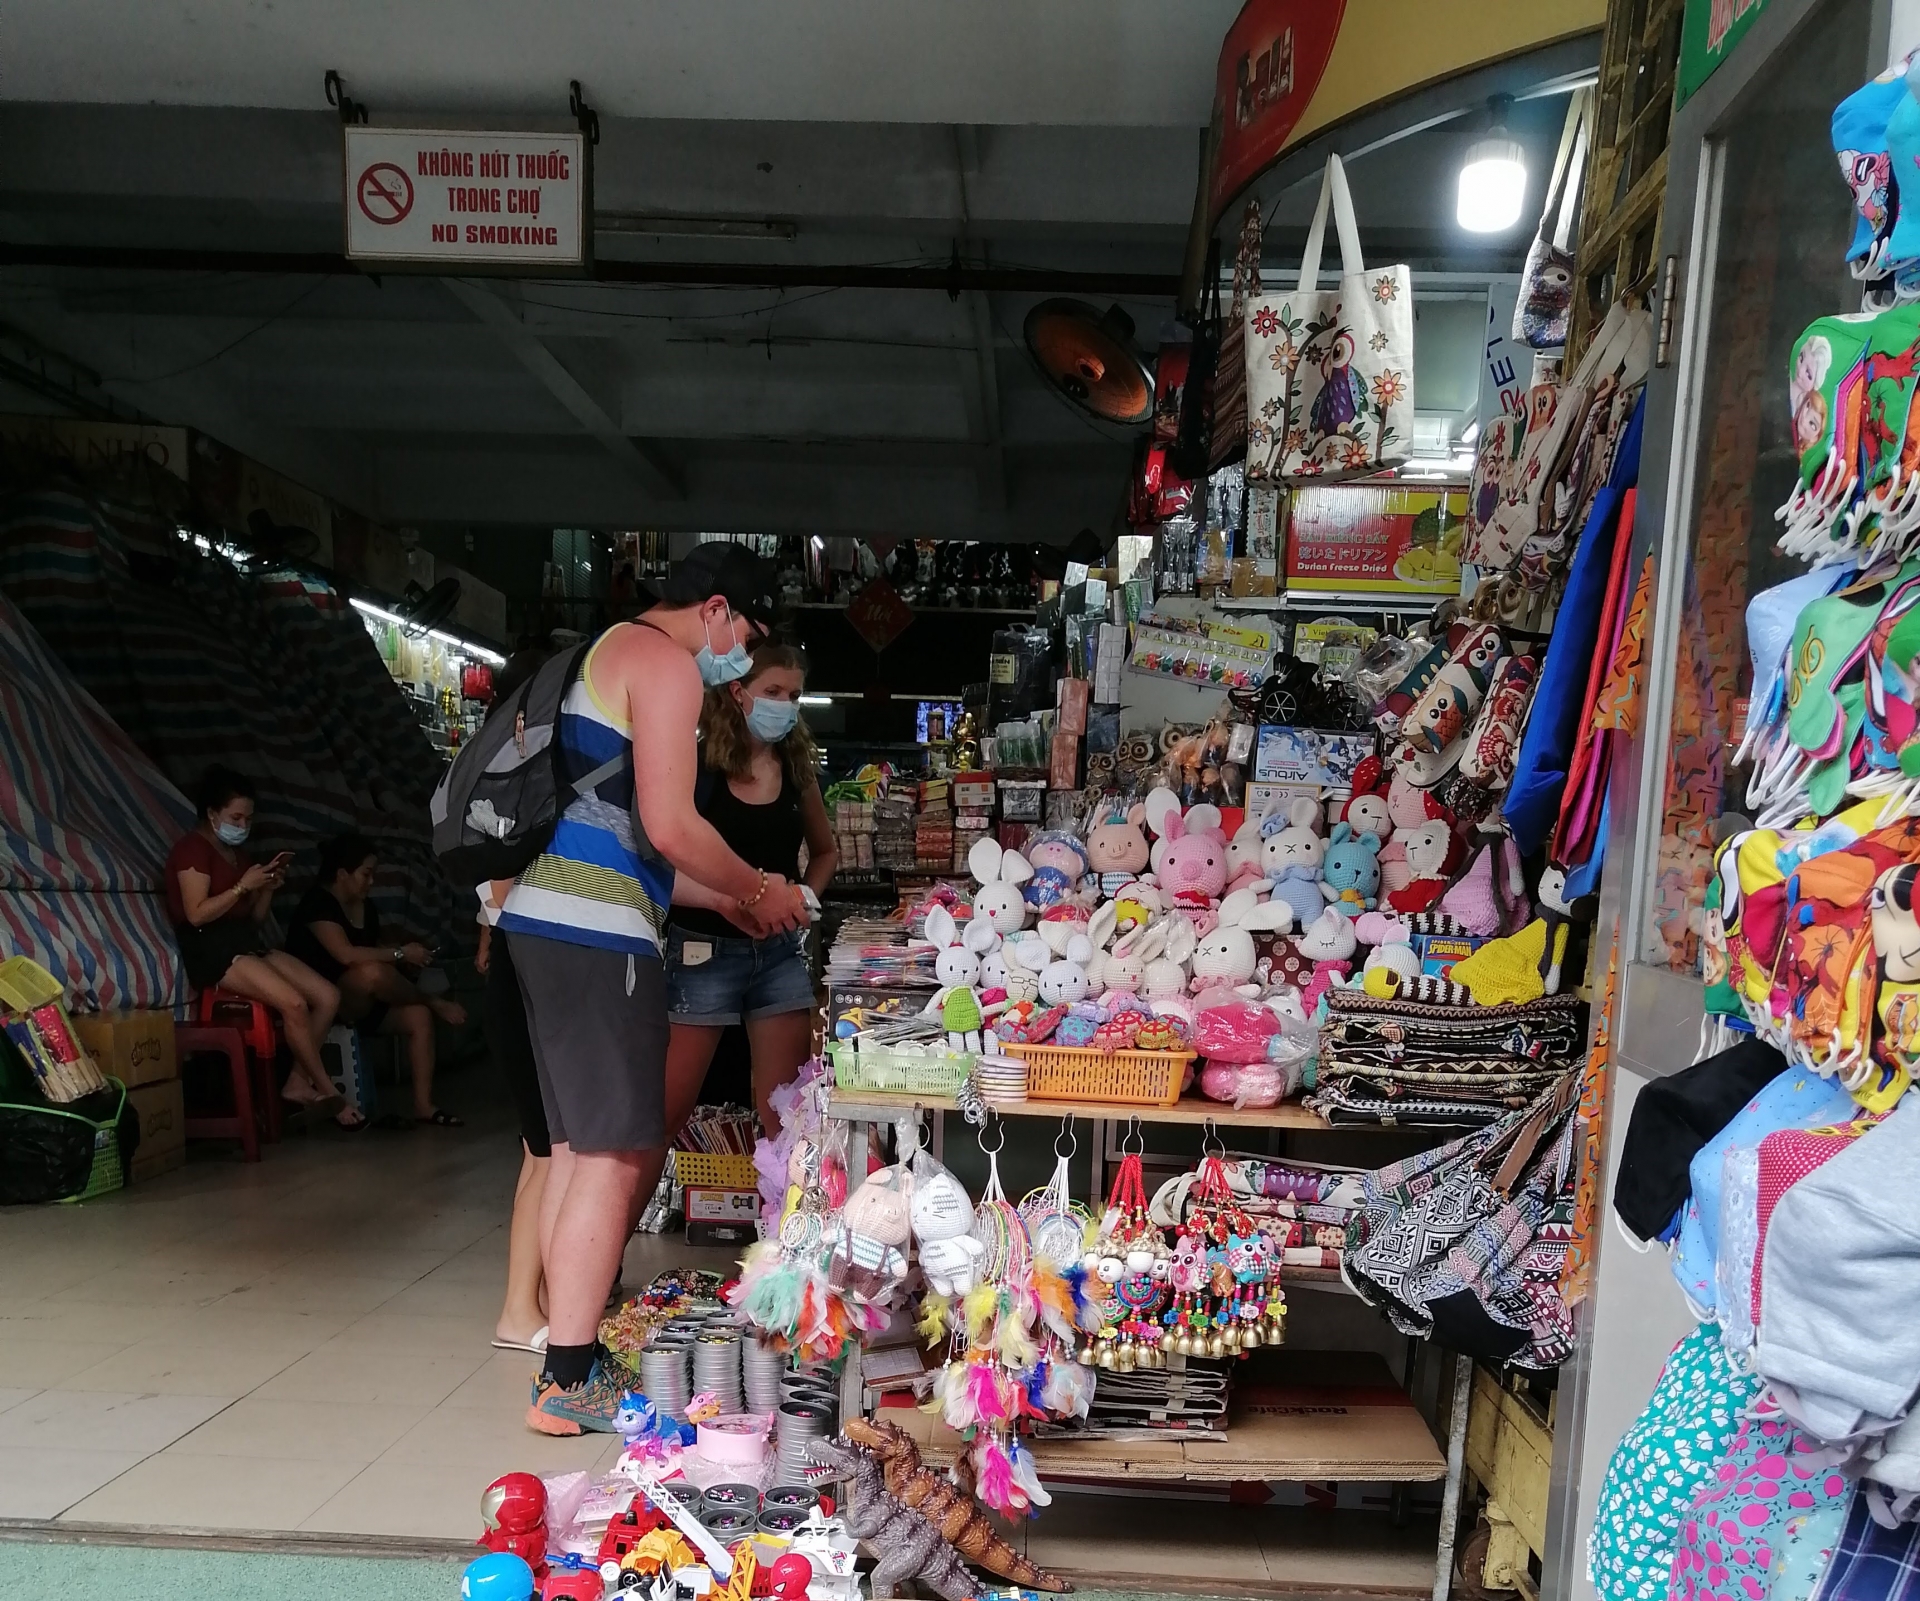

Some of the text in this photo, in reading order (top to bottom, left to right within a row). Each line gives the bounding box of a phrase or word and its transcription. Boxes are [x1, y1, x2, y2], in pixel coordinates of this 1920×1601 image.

[417, 148, 569, 180] KHÔNG HÚT THUỐC
[447, 185, 542, 220] TRONG CHỢ
[432, 224, 558, 245] NO SMOKING
[1297, 562, 1327, 571] Durian
[1362, 564, 1387, 573] Dried
[1427, 944, 1472, 957] SPIDER-MAN
